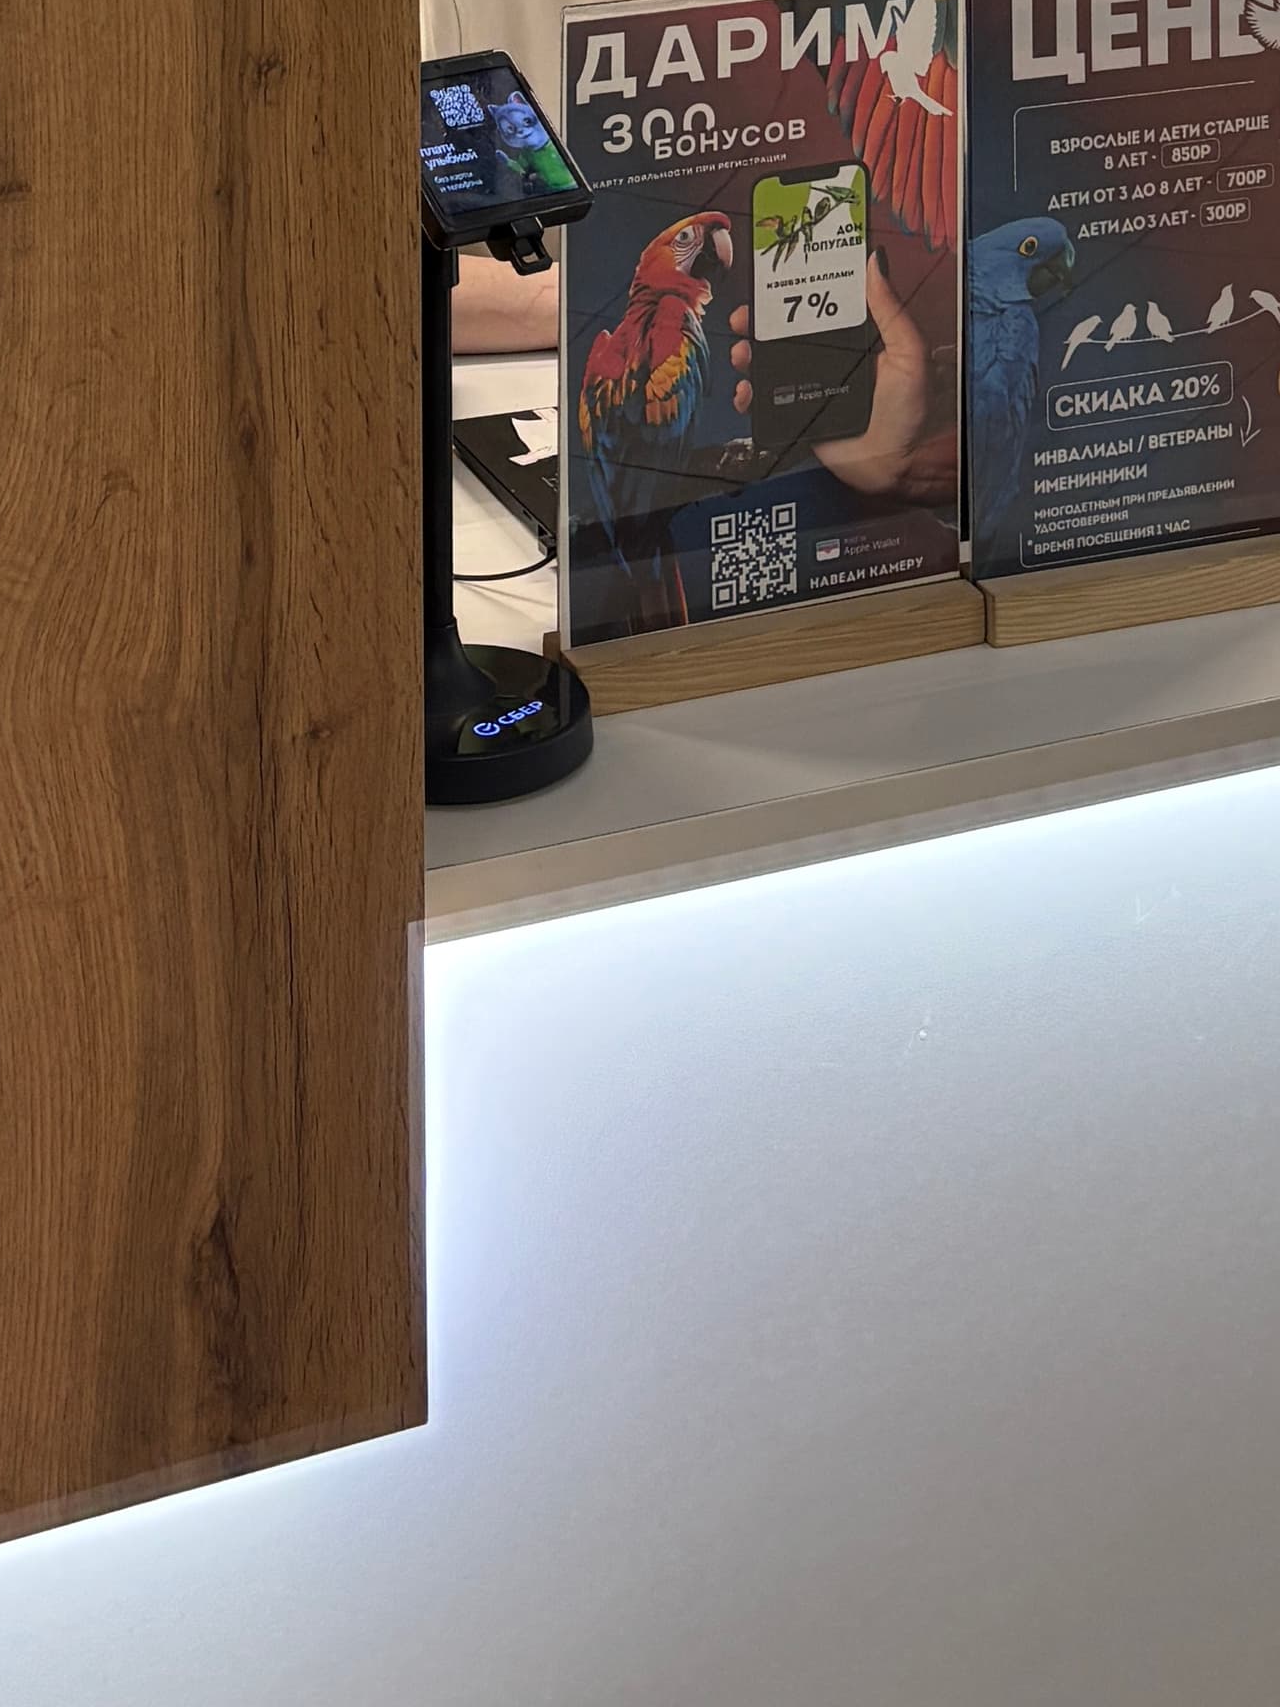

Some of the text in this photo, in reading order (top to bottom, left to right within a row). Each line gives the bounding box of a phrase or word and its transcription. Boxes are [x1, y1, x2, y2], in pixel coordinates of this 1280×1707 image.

[654, 119, 806, 160] БОНУСОВ
[1050, 115, 1270, 155] ВЗРОСЛЫЕ И ДЕТИ СТАРШЕ
[627, 167, 693, 185] ЛОЯЛЬНОСТИ
[696, 163, 715, 174] ПРИ
[718, 153, 787, 170] РЕГИСТРАЦИИ
[1104, 156, 1113, 170] 8
[1117, 151, 1148, 168] ЛЕТ
[1048, 191, 1090, 211] ДЕТИ
[1093, 188, 1115, 204] ОТ
[1119, 185, 1128, 200] 3
[1131, 182, 1156, 199] ДО
[1159, 180, 1169, 195] 8
[1172, 175, 1203, 193] ЛЕТ
[1077, 219, 1119, 239] ДЕТИ
[1121, 215, 1146, 234] ДО
[1148, 214, 1157, 229] 3
[803, 237, 863, 253] ПОПУГАЕВ
[810, 270, 854, 283] БАЛЛАМИ
[1055, 373, 1220, 417] СКИДКА 20%
[1034, 438, 1133, 467] ИНВАЛИДЫ
[1148, 423, 1233, 450] ВЕТЕРАНЫ
[1034, 463, 1148, 494] ИМЕНИННИКИ
[1034, 479, 1235, 521] МНОГОДЕТНЫМ ПРИ ПРЕДЪЯВЛЕНИИ
[1034, 510, 1129, 535] УДОСТОВЕРЕНИЯ
[1077, 522, 1155, 548] ПОСЕЩЕНИЯ
[1156, 523, 1163, 535] 1
[1165, 519, 1190, 533] ЧАС
[810, 556, 924, 589] НАВЕДИ КАМЕРУ
[498, 700, 543, 724] СБЕР
